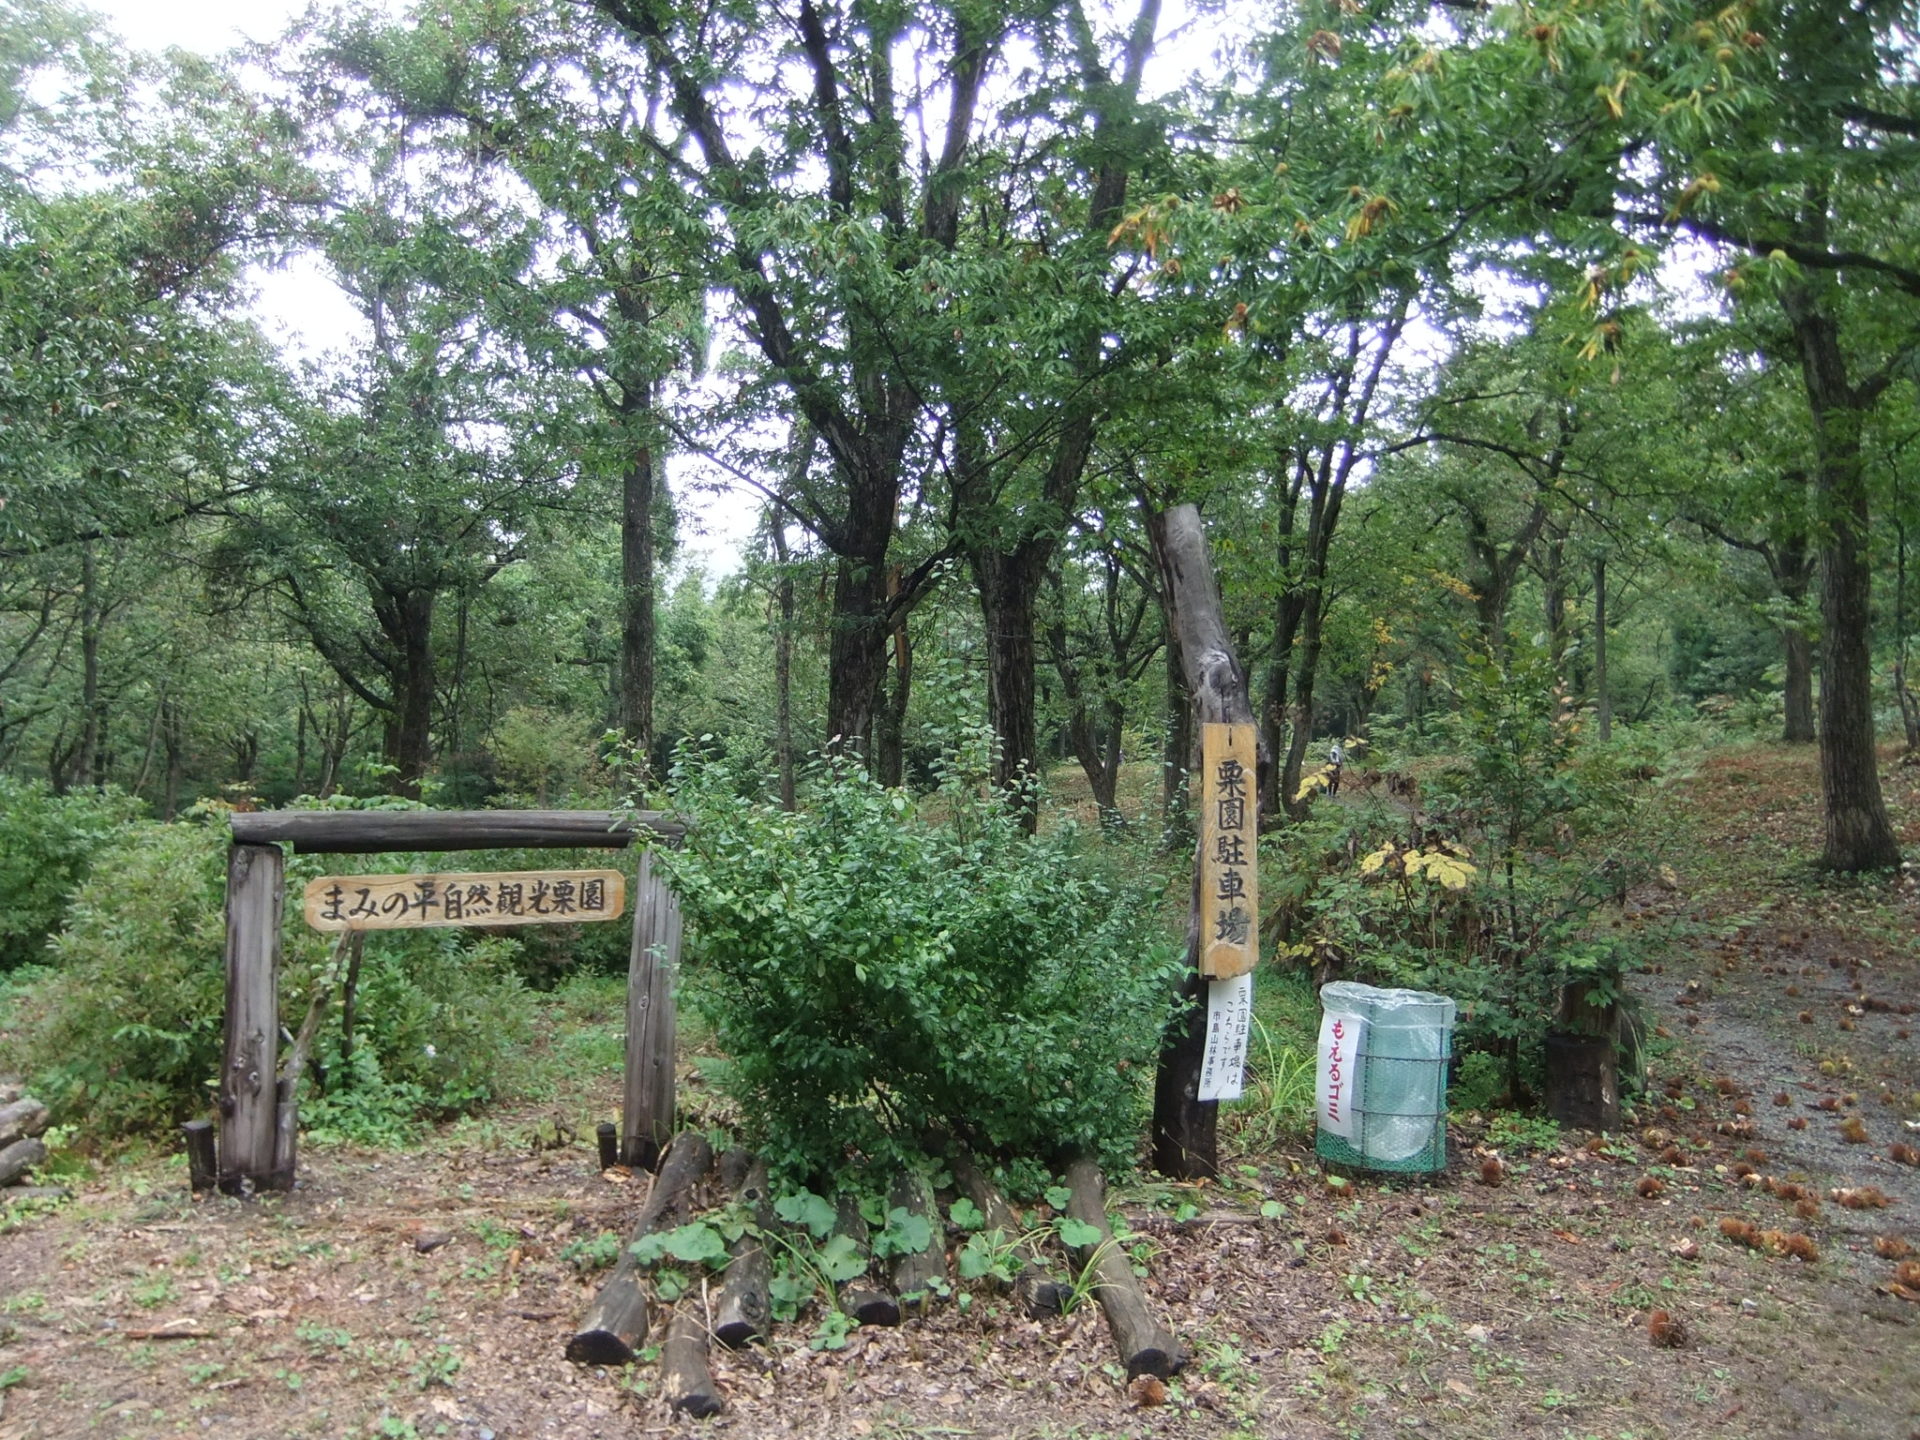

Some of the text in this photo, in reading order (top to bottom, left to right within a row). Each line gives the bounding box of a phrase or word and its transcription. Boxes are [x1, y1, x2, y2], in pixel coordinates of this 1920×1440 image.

[1212, 760, 1250, 944] 栗園駐車場
[321, 879, 604, 920] まみの平自然観光栗園
[1220, 1001, 1234, 1071] こちらです
[1328, 1018, 1345, 1123] もえるゴミ
